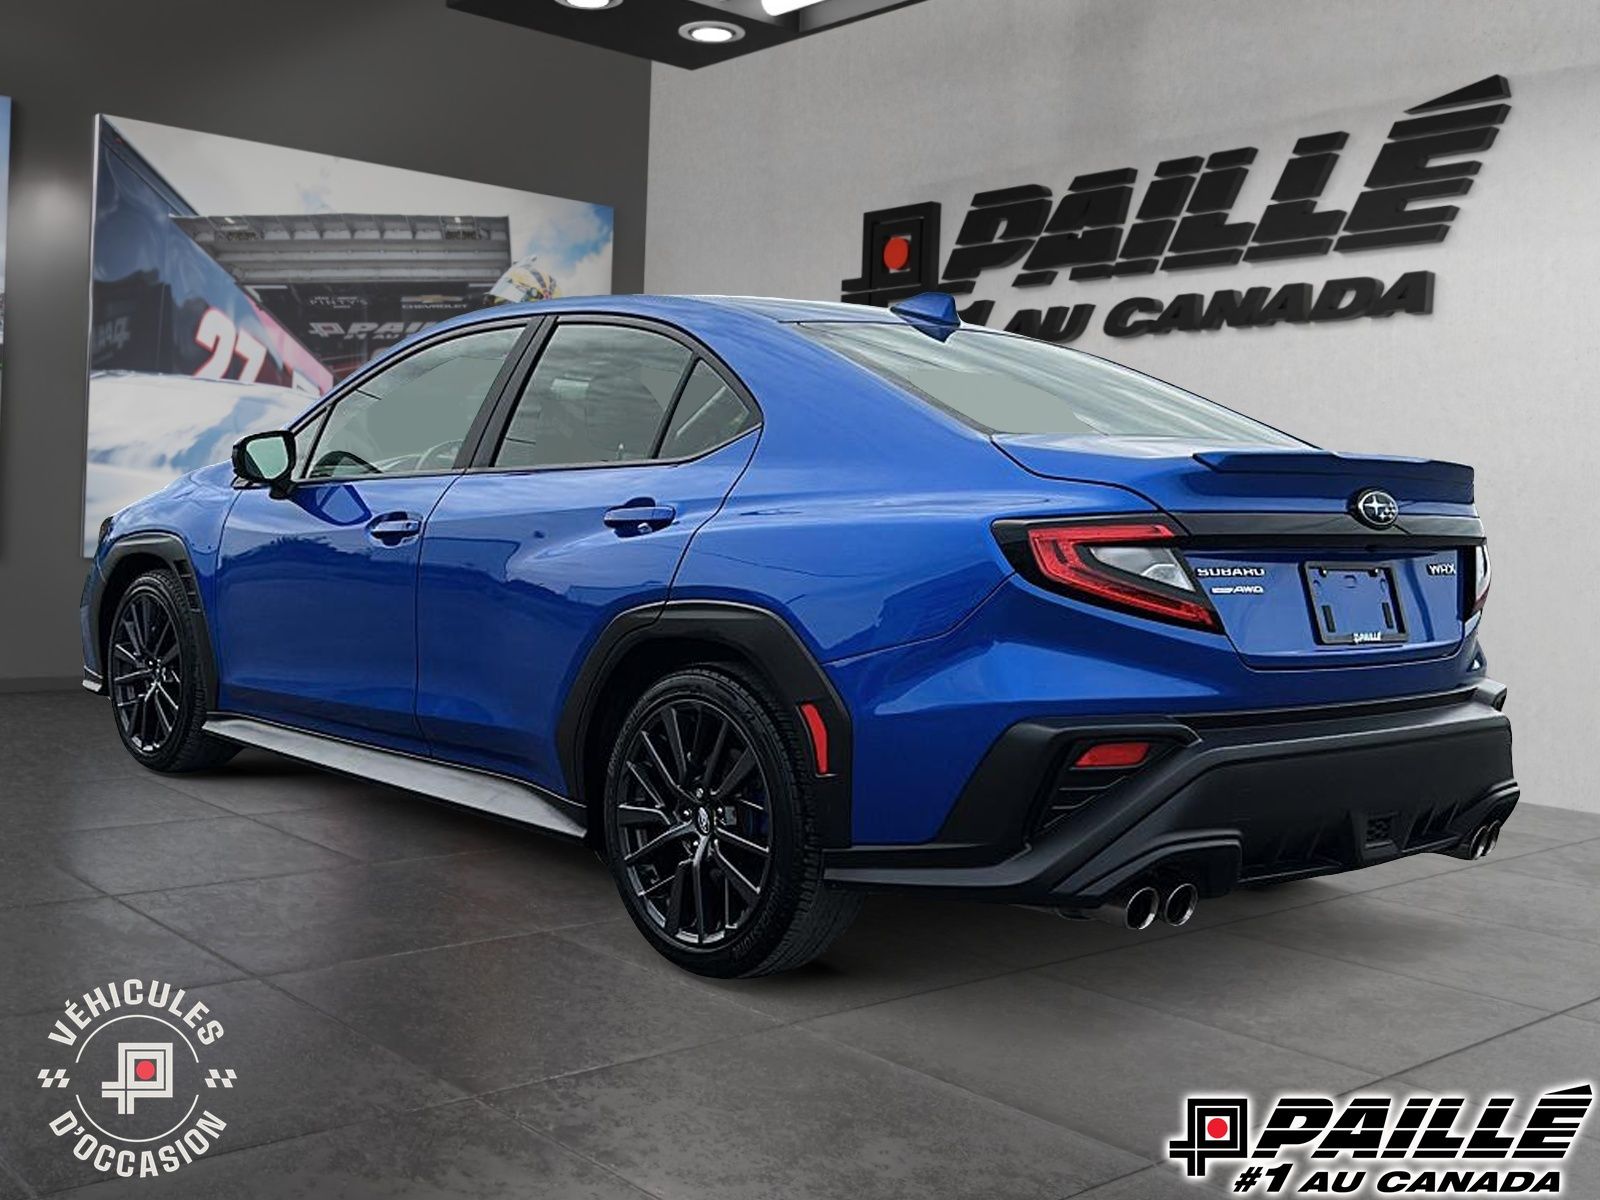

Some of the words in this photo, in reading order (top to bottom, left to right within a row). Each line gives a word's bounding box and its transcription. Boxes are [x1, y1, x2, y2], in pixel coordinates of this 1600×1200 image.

[938, 74, 1511, 294] PAILLÉ
[1003, 303, 1097, 343] AU
[1104, 270, 1436, 338] CANADA
[193, 307, 267, 384] 27
[1197, 567, 1265, 577] SUBARU
[1232, 585, 1264, 594] AWD
[1427, 563, 1457, 575] WRX
